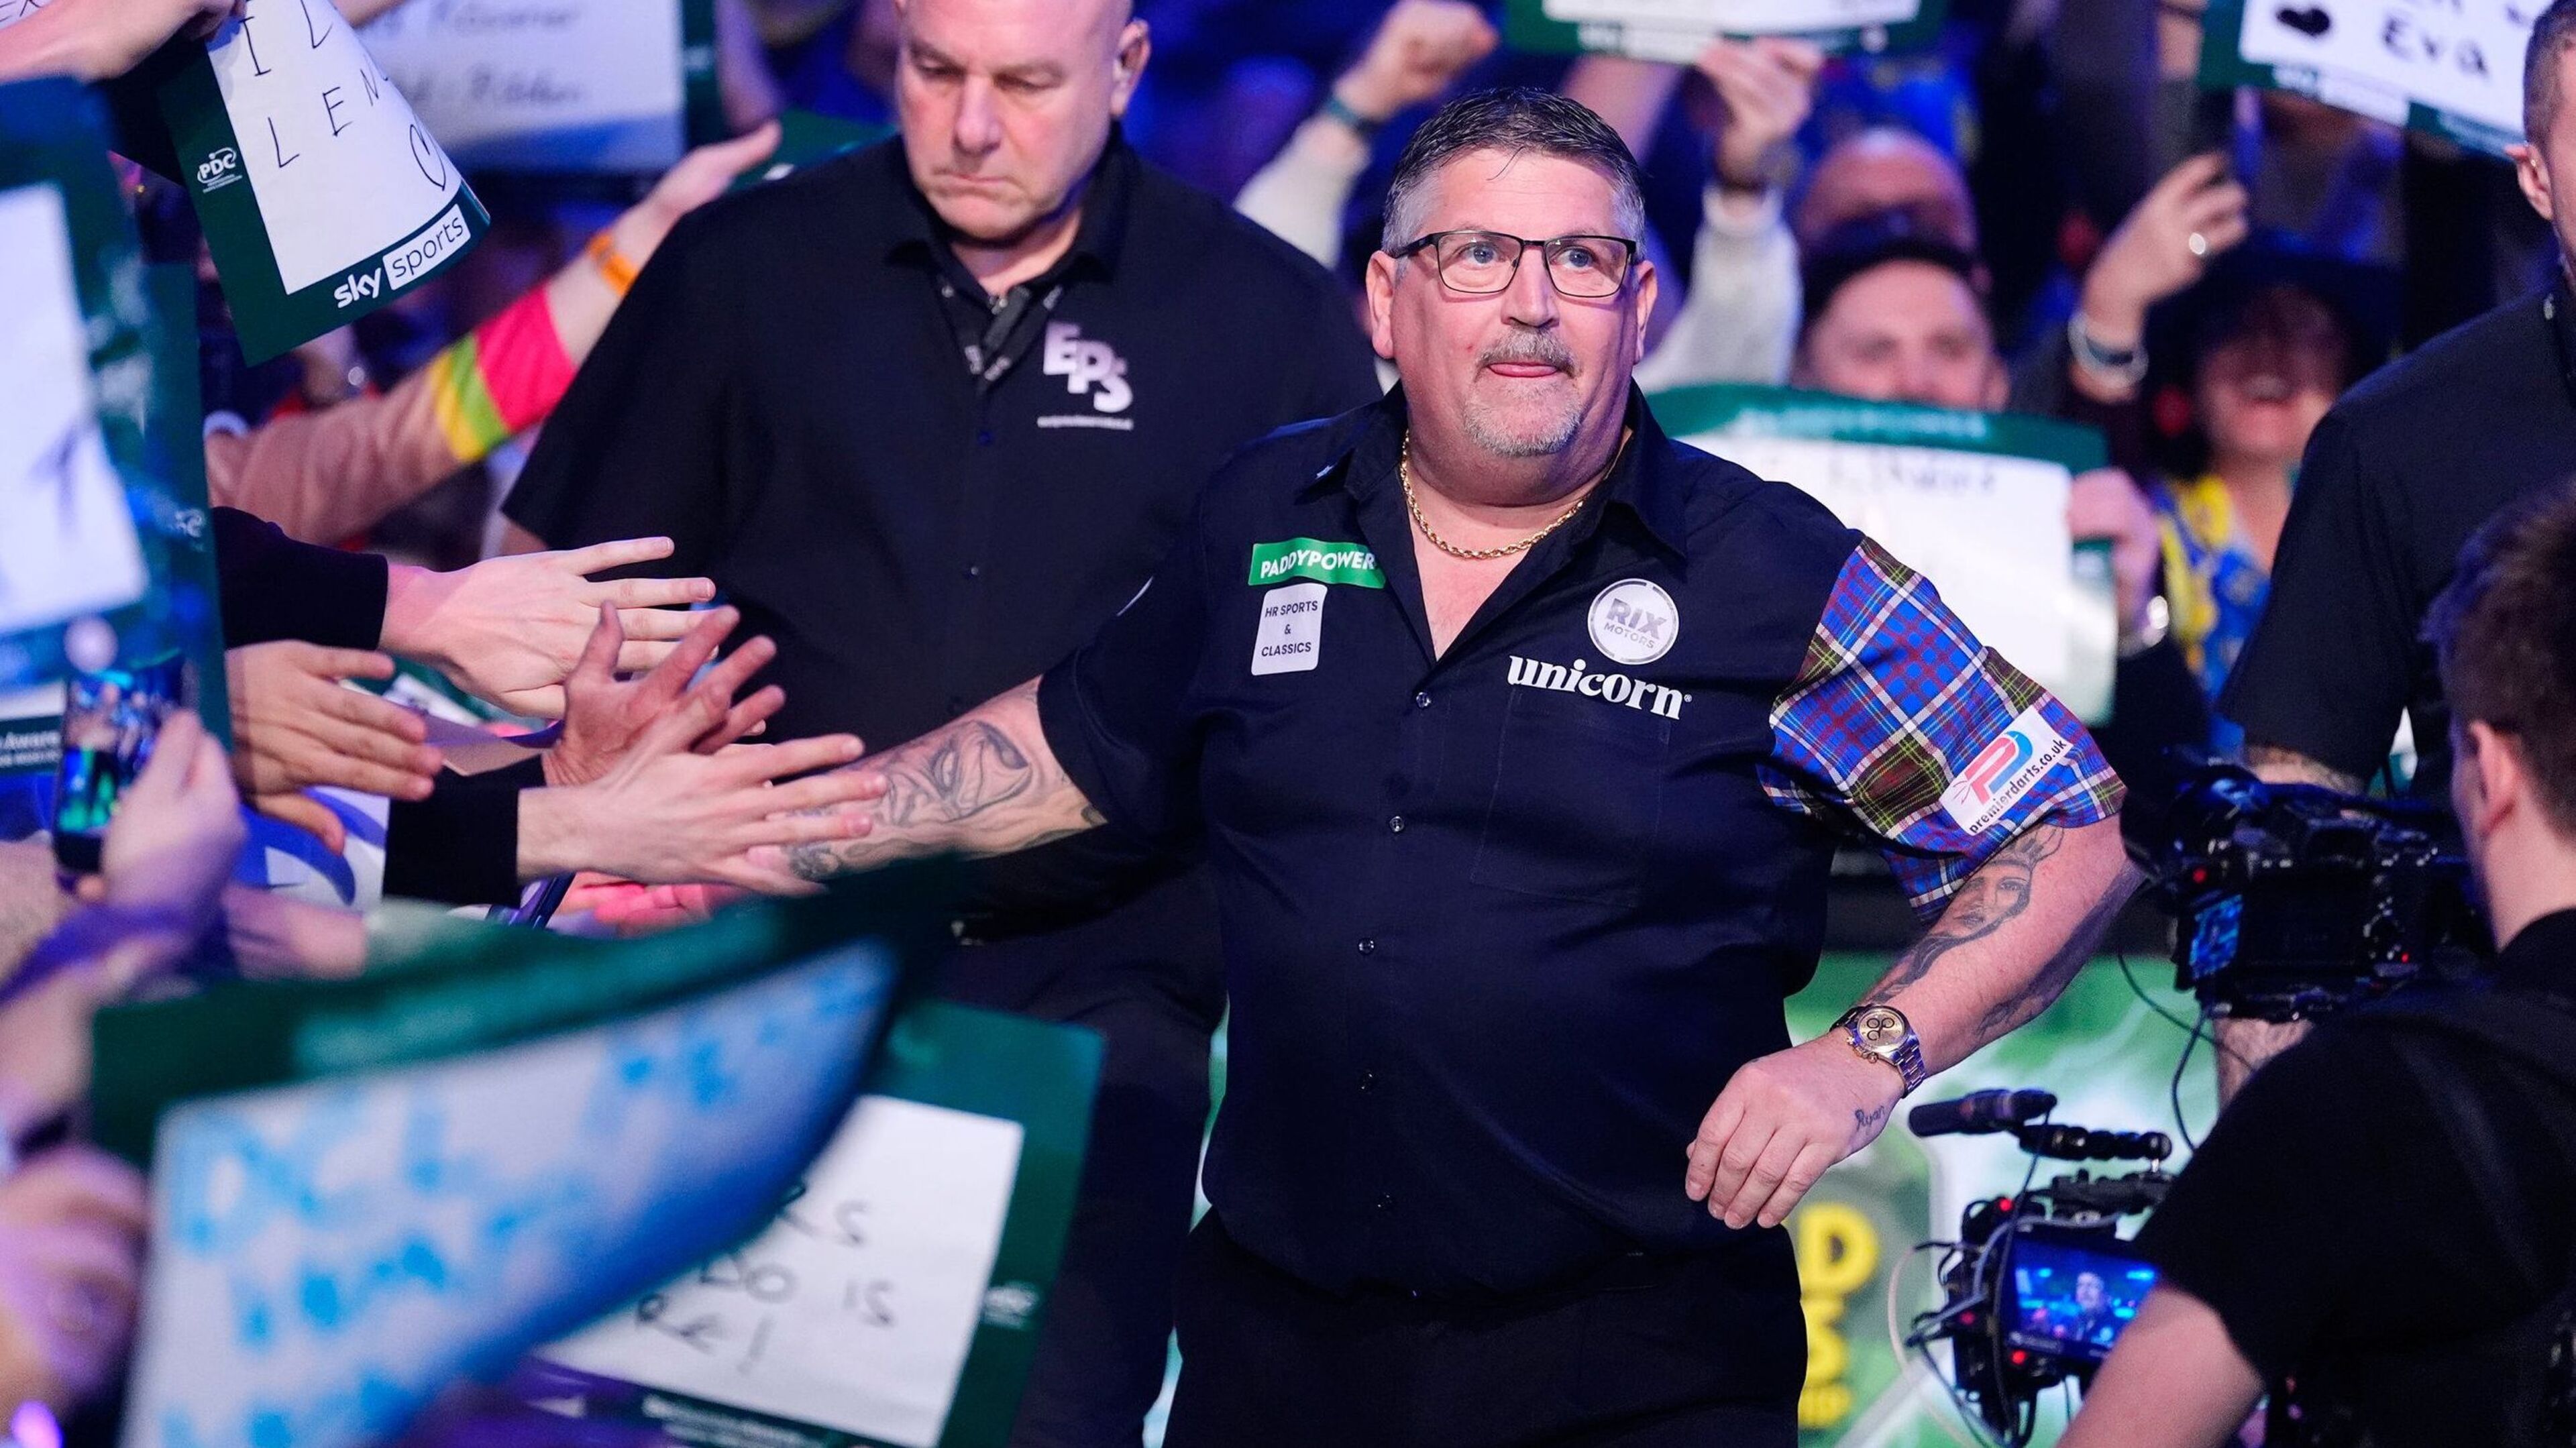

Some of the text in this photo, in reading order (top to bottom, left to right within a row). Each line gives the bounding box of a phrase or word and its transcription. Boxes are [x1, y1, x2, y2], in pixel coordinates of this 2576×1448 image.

[199, 152, 237, 180] PDC
[334, 217, 464, 309] sky sports
[1042, 321, 1133, 413] EPS
[1260, 549, 1376, 579] PADDYPOWER
[1265, 600, 1318, 618] HR SPORTS
[1606, 598, 1668, 640] RIX
[1284, 624, 1291, 634] &
[1603, 622, 1656, 649] MOTORS
[1260, 642, 1312, 657] CLASSICS
[1969, 738, 2068, 834] premierdarts.co.uk
